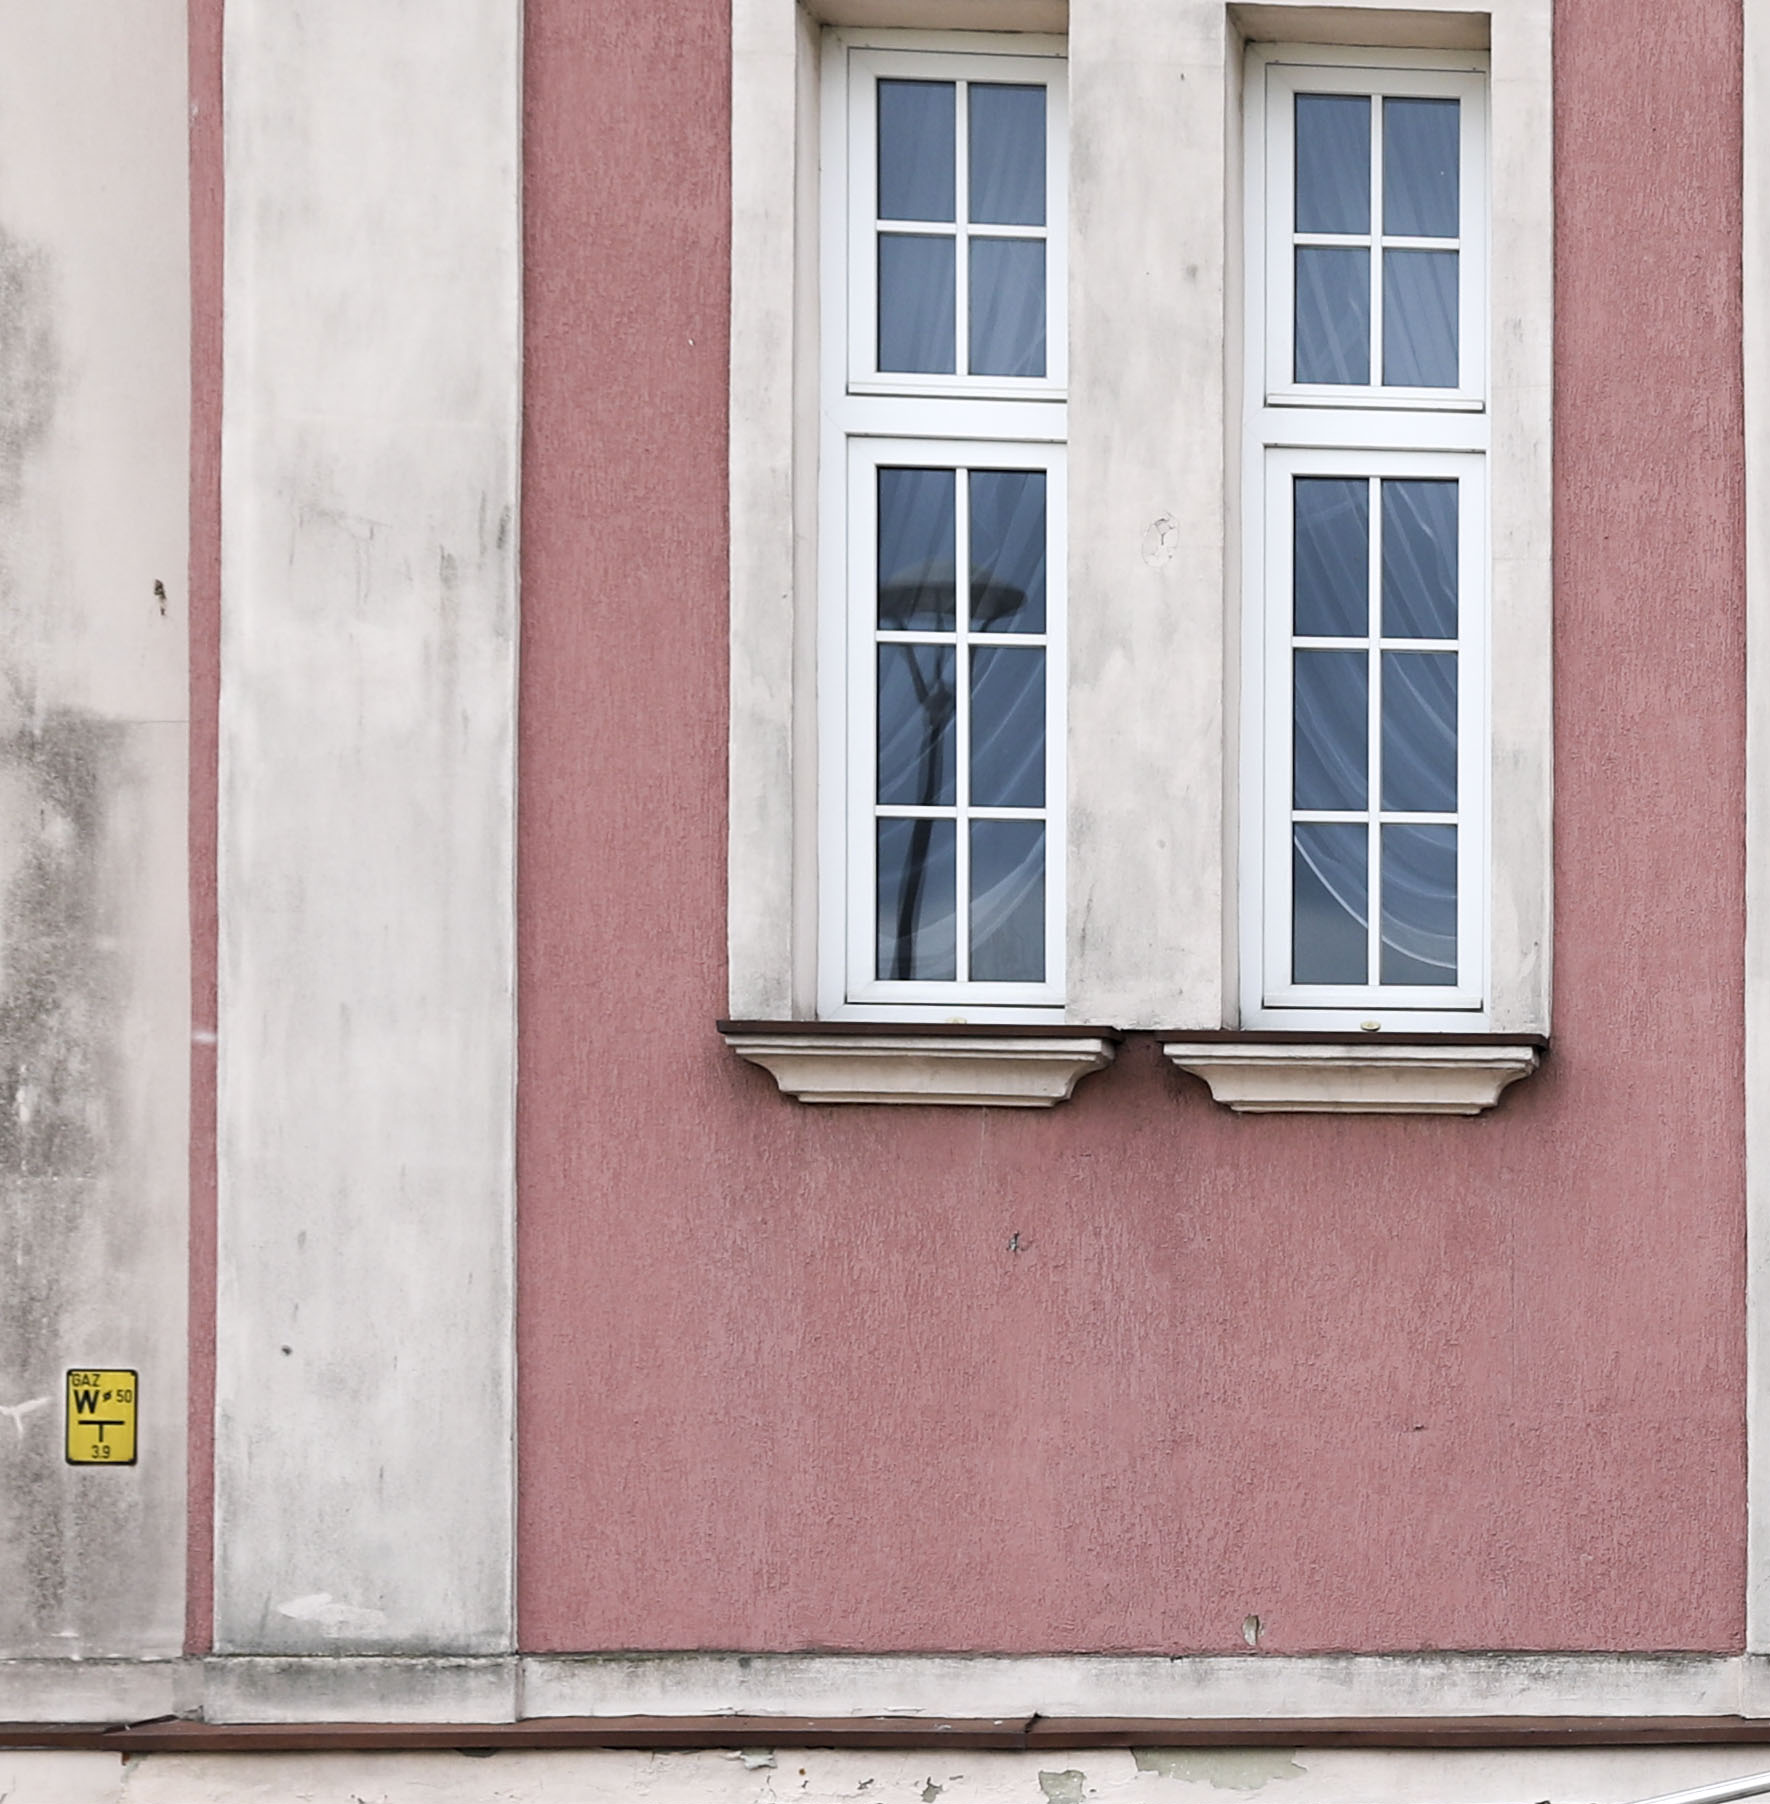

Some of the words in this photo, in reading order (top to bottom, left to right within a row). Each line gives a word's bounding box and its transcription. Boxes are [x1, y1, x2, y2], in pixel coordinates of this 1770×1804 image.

[72, 1373, 101, 1387] GAZ
[73, 1389, 100, 1414] W
[116, 1389, 132, 1403] 50
